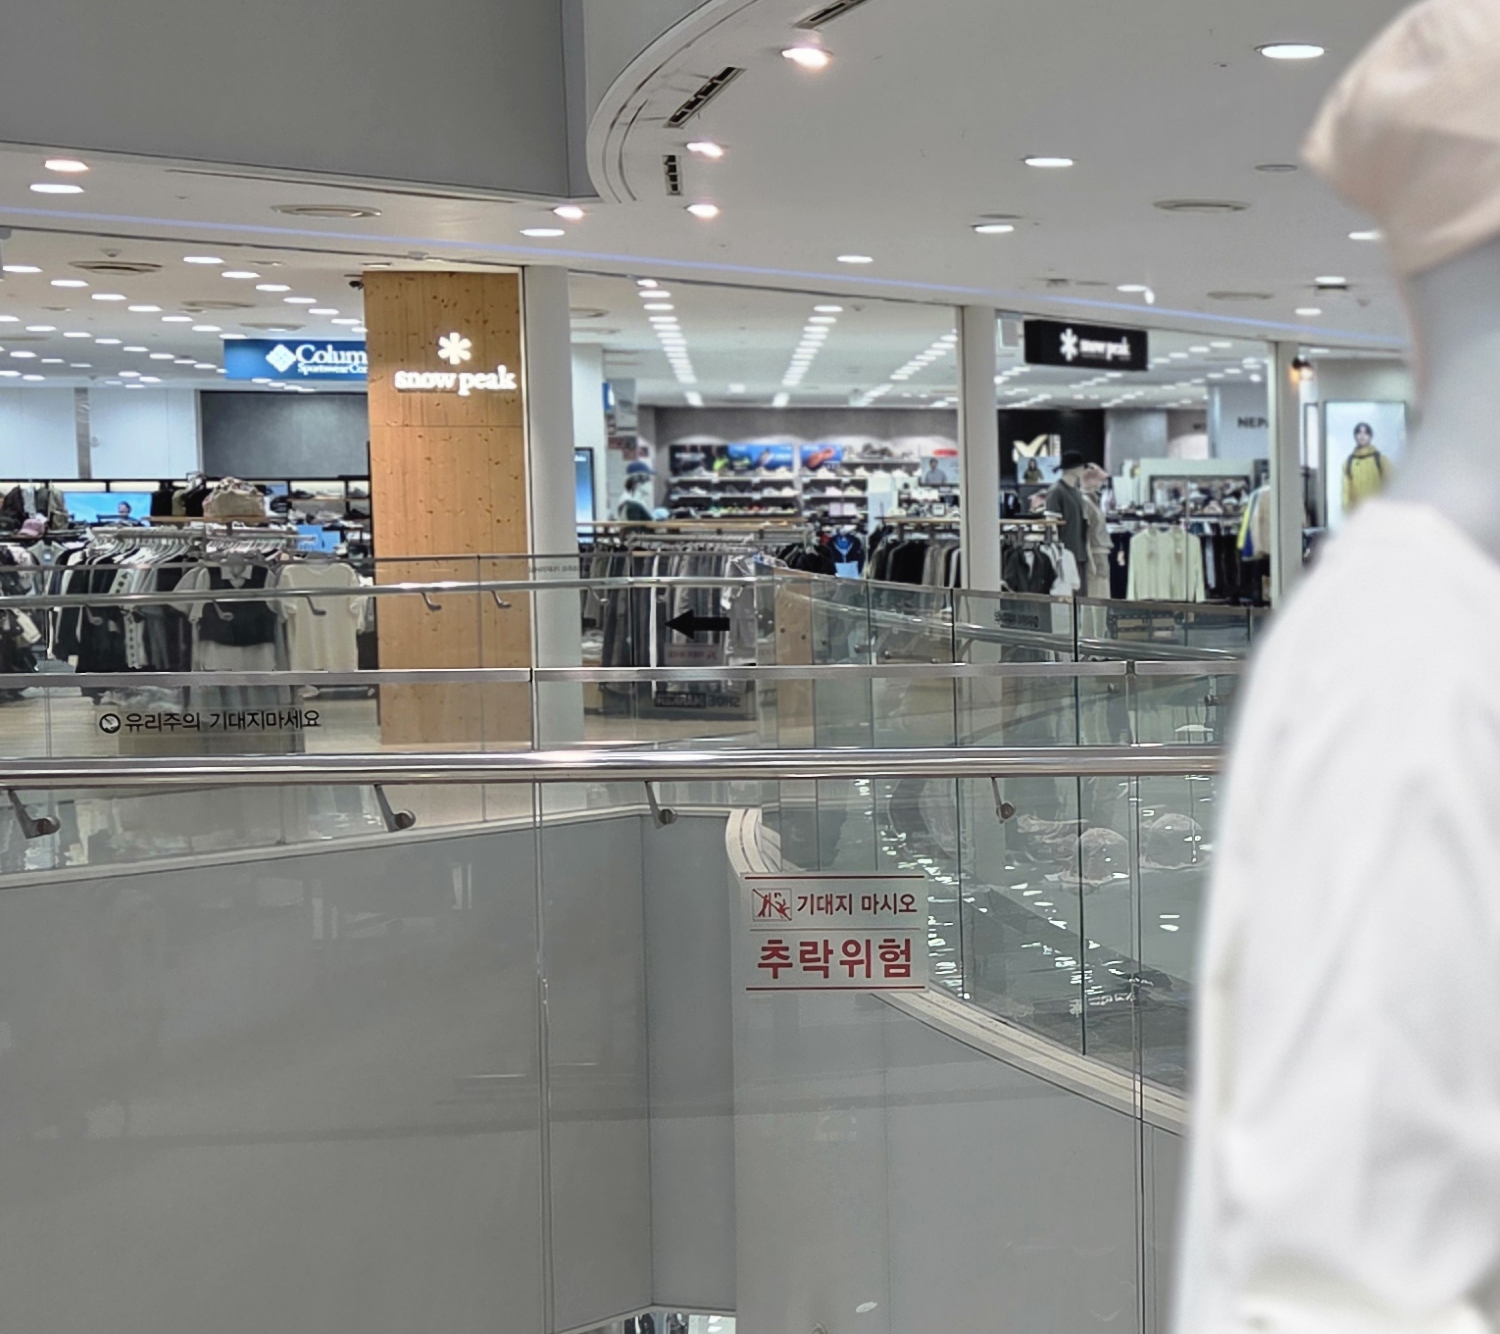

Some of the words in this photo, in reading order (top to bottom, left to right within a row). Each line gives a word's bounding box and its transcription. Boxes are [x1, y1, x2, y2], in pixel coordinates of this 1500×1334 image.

[296, 344, 368, 364] Colum
[394, 371, 457, 389] snow
[458, 364, 518, 396] peak
[125, 712, 200, 733] 유리주의
[209, 709, 322, 731] 기대지마세요
[797, 892, 853, 916] 기대지
[861, 892, 918, 915] 마시오
[757, 938, 911, 980] 추락위험
